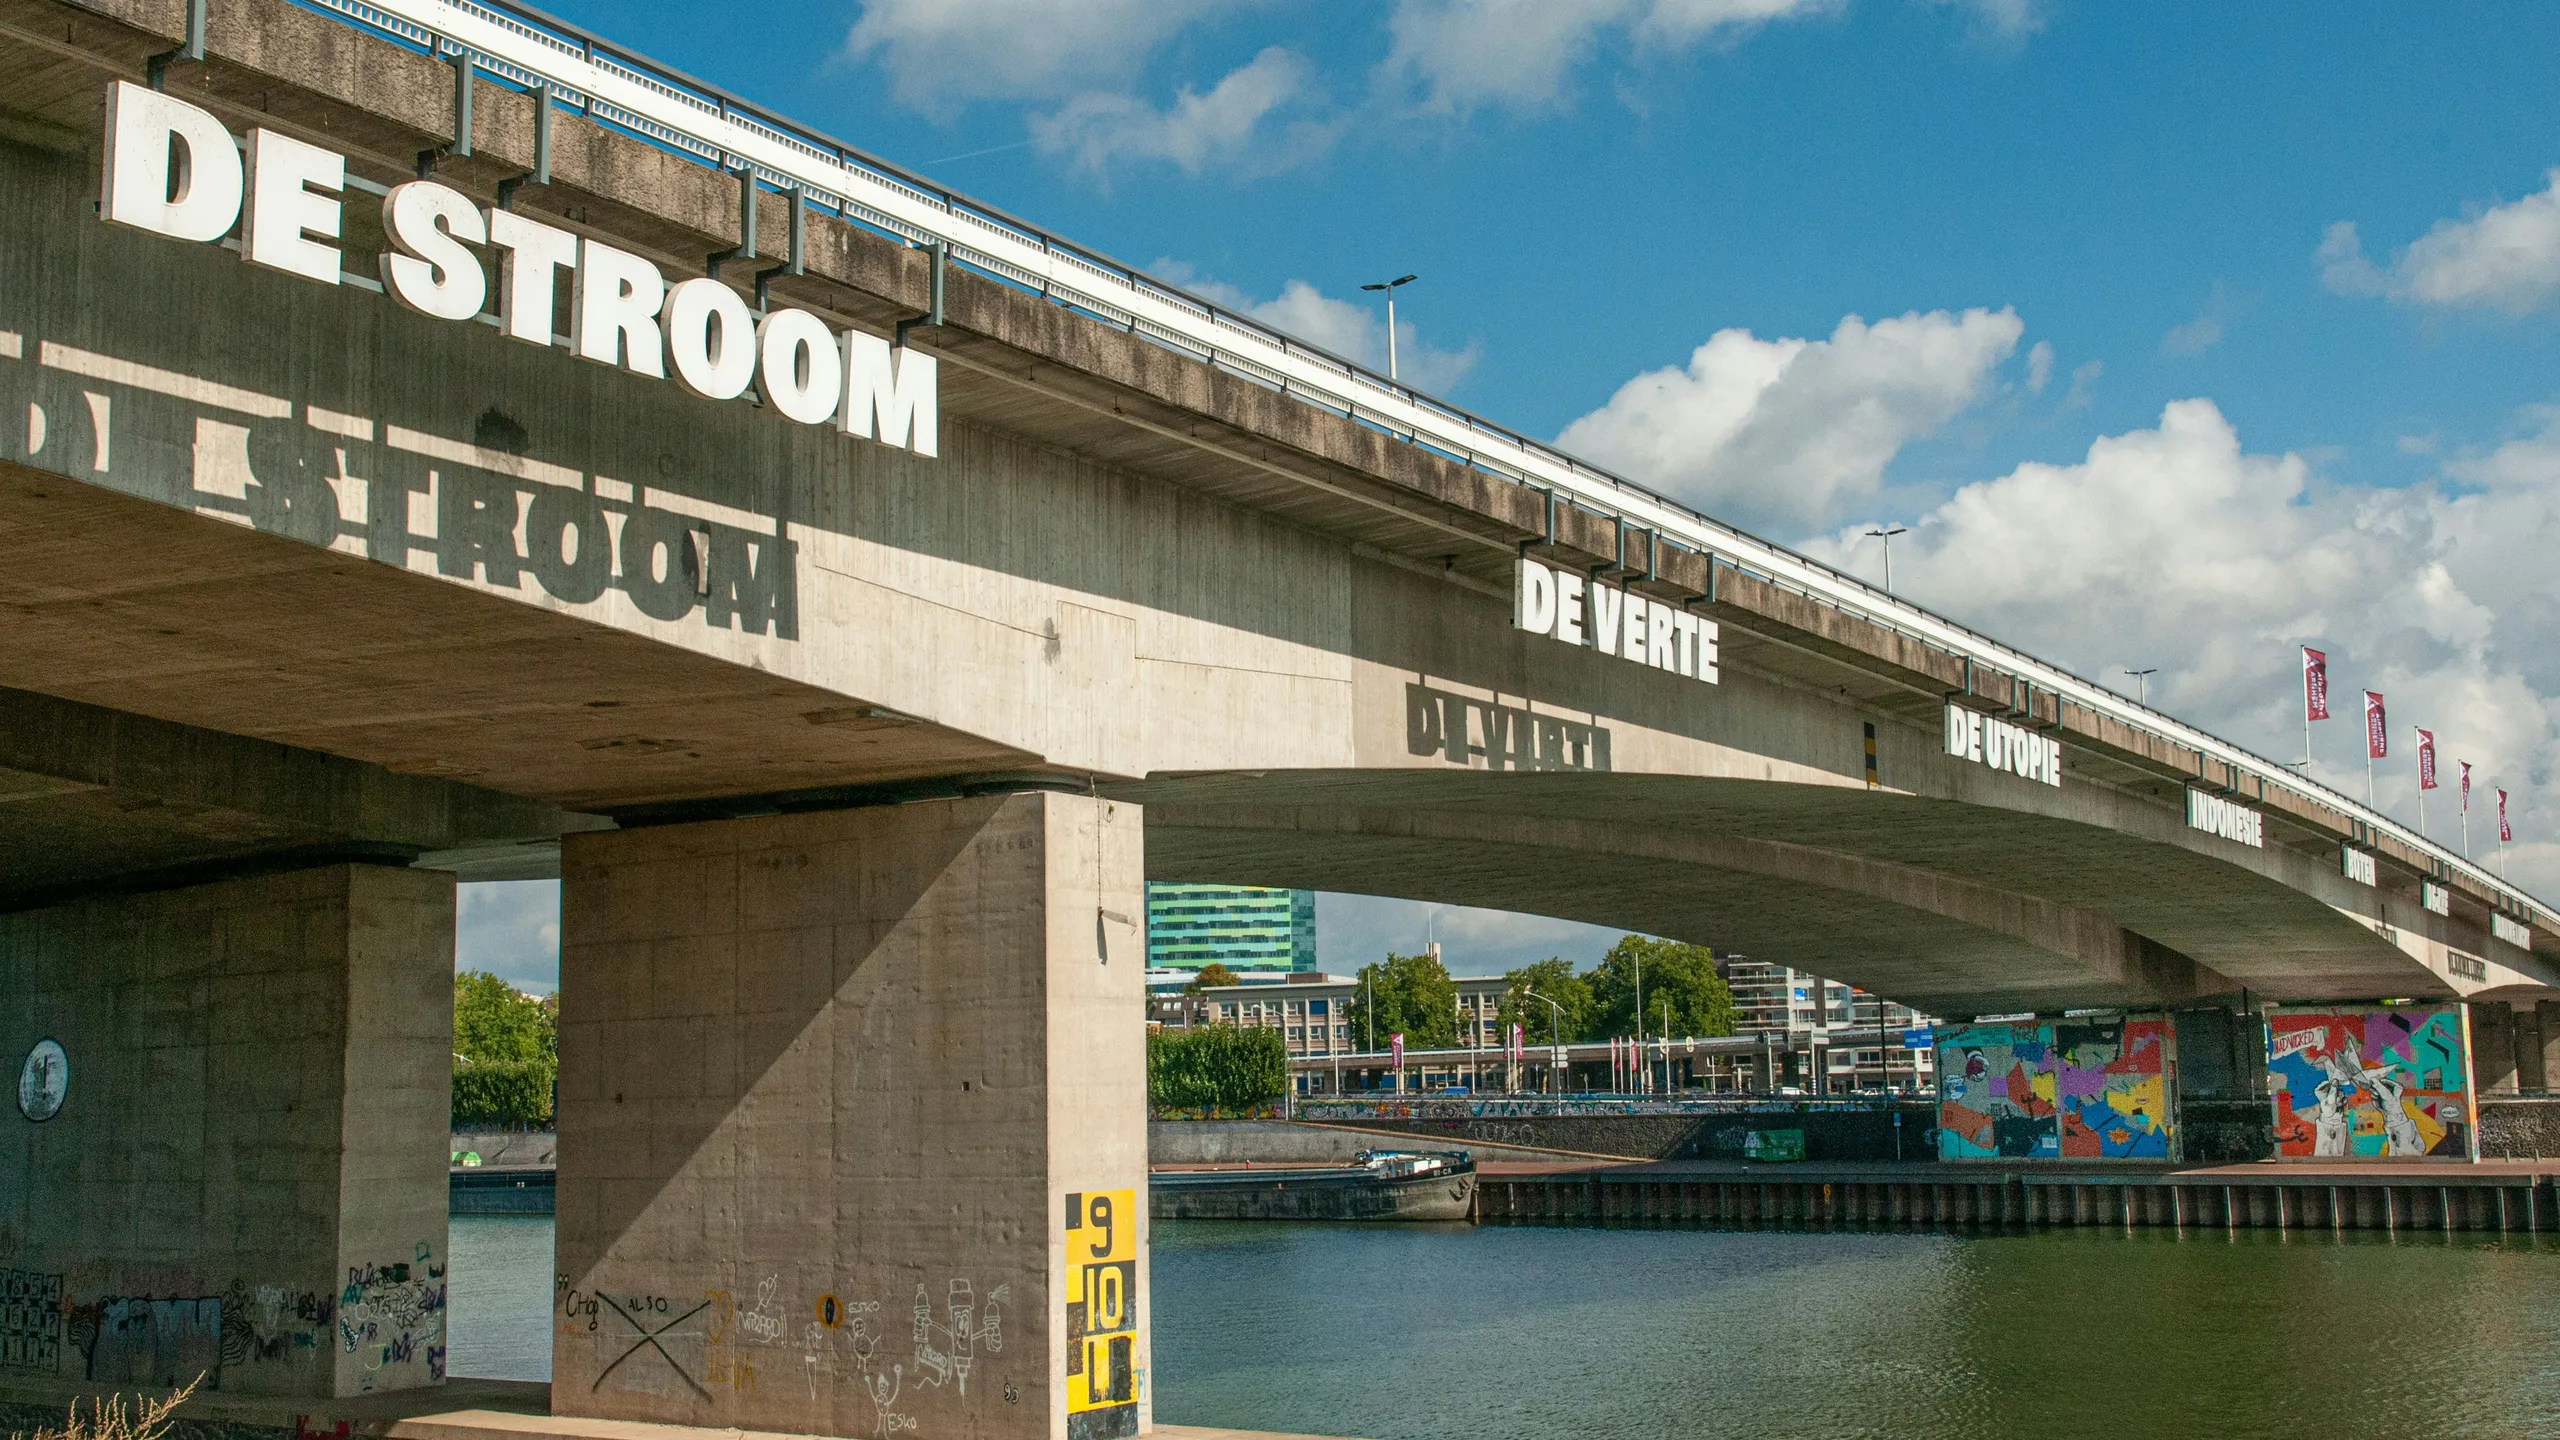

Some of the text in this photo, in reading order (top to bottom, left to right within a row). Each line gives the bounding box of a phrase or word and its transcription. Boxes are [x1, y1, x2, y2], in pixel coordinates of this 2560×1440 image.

[100, 80, 344, 285] DE
[379, 180, 938, 458] STROOM
[1514, 558, 1718, 685] DE VERTE
[1944, 704, 2060, 787] DE UTOPIE
[2187, 789, 2262, 848] INDONESIE
[1090, 1196, 1112, 1258] 9
[1087, 1266, 1123, 1332] 10
